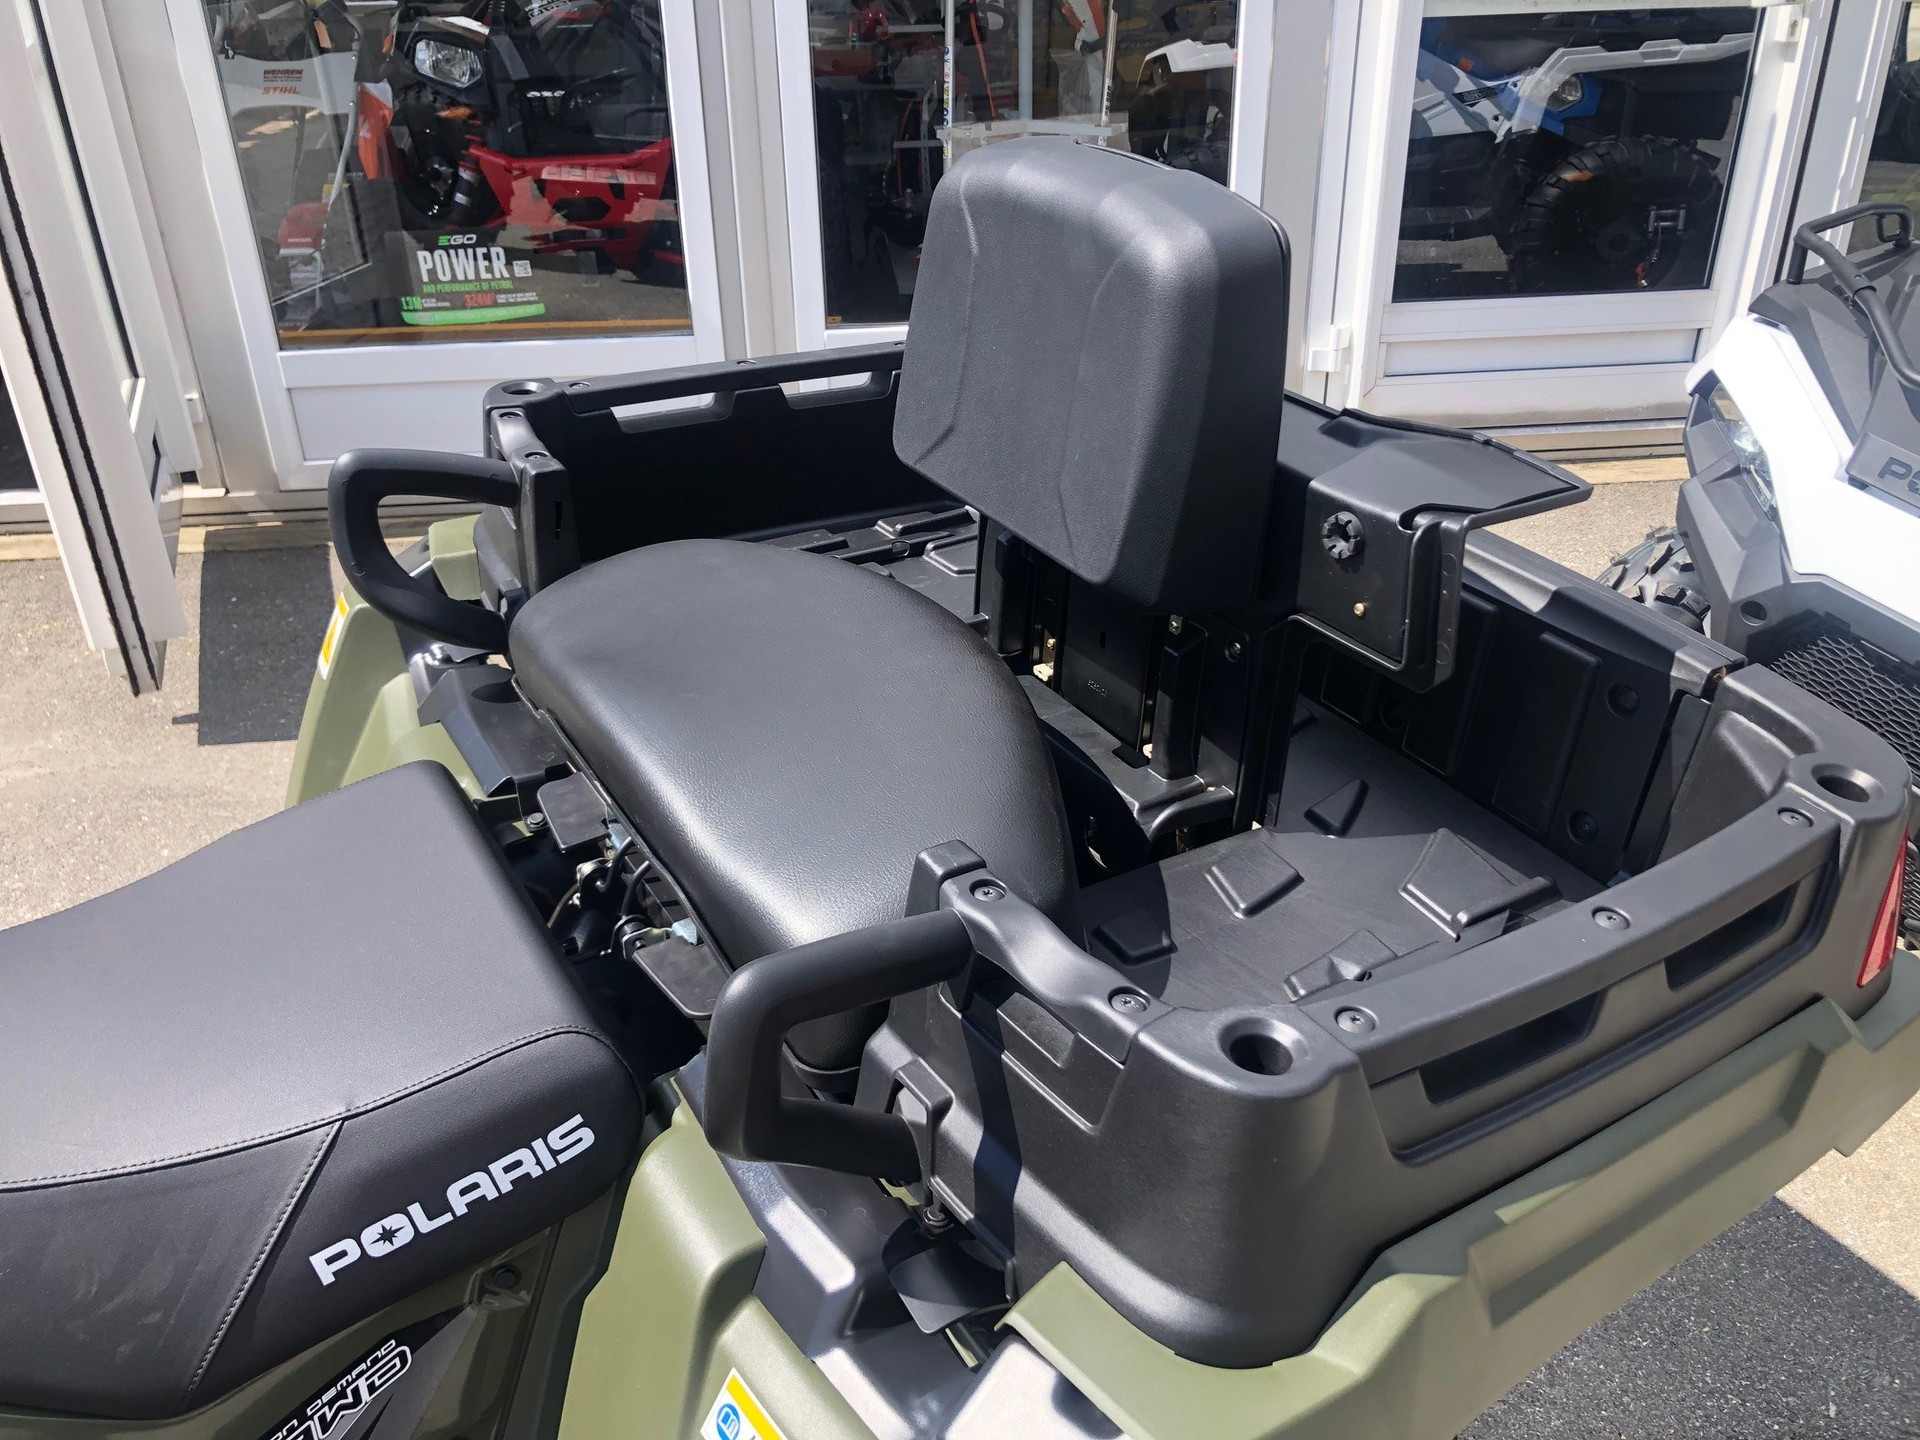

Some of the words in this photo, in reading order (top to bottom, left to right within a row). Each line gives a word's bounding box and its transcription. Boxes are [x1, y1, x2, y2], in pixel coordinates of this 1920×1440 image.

[262, 86, 300, 95] STIHL
[438, 233, 477, 246] EGO
[416, 246, 511, 282] POWER
[308, 1113, 596, 1287] POLARIS
